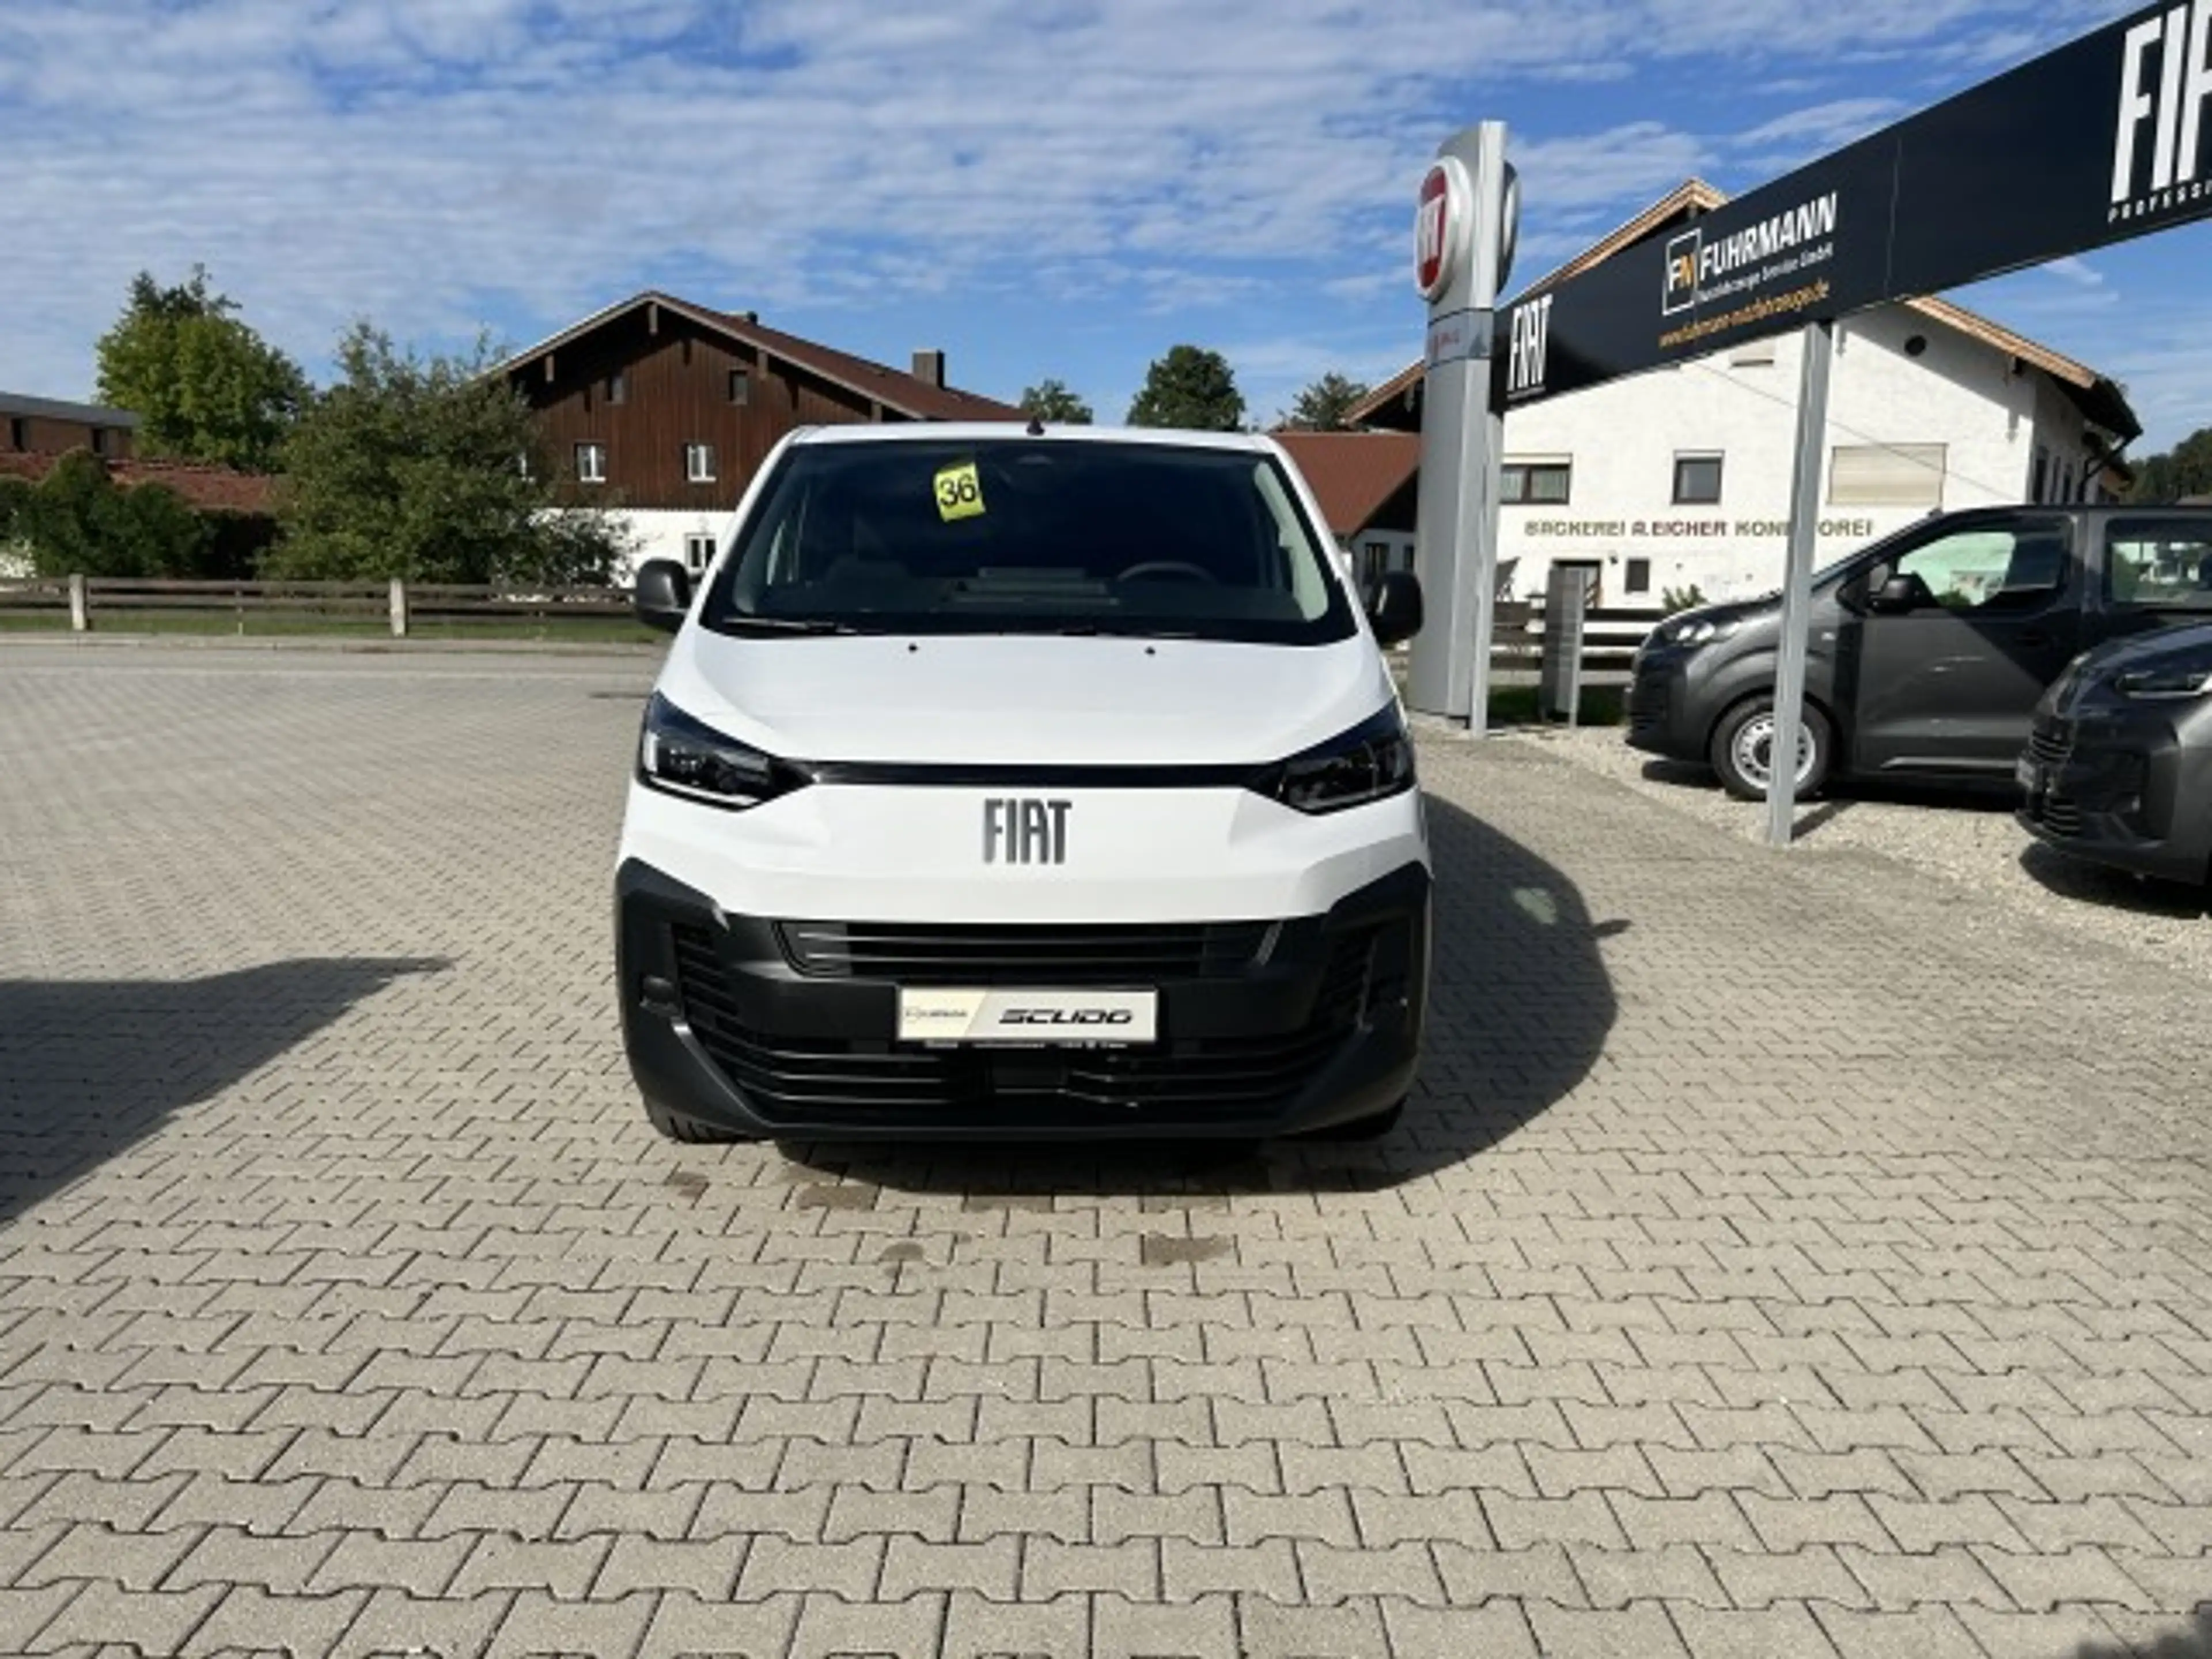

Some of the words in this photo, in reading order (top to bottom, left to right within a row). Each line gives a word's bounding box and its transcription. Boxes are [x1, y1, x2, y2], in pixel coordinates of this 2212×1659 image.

[1700, 190, 1837, 281] FUHRMANN
[1507, 293, 1553, 392] FIAT
[940, 473, 977, 507] 36
[983, 797, 1073, 865] FIAT
[999, 1008, 1133, 1025] SCUDO
